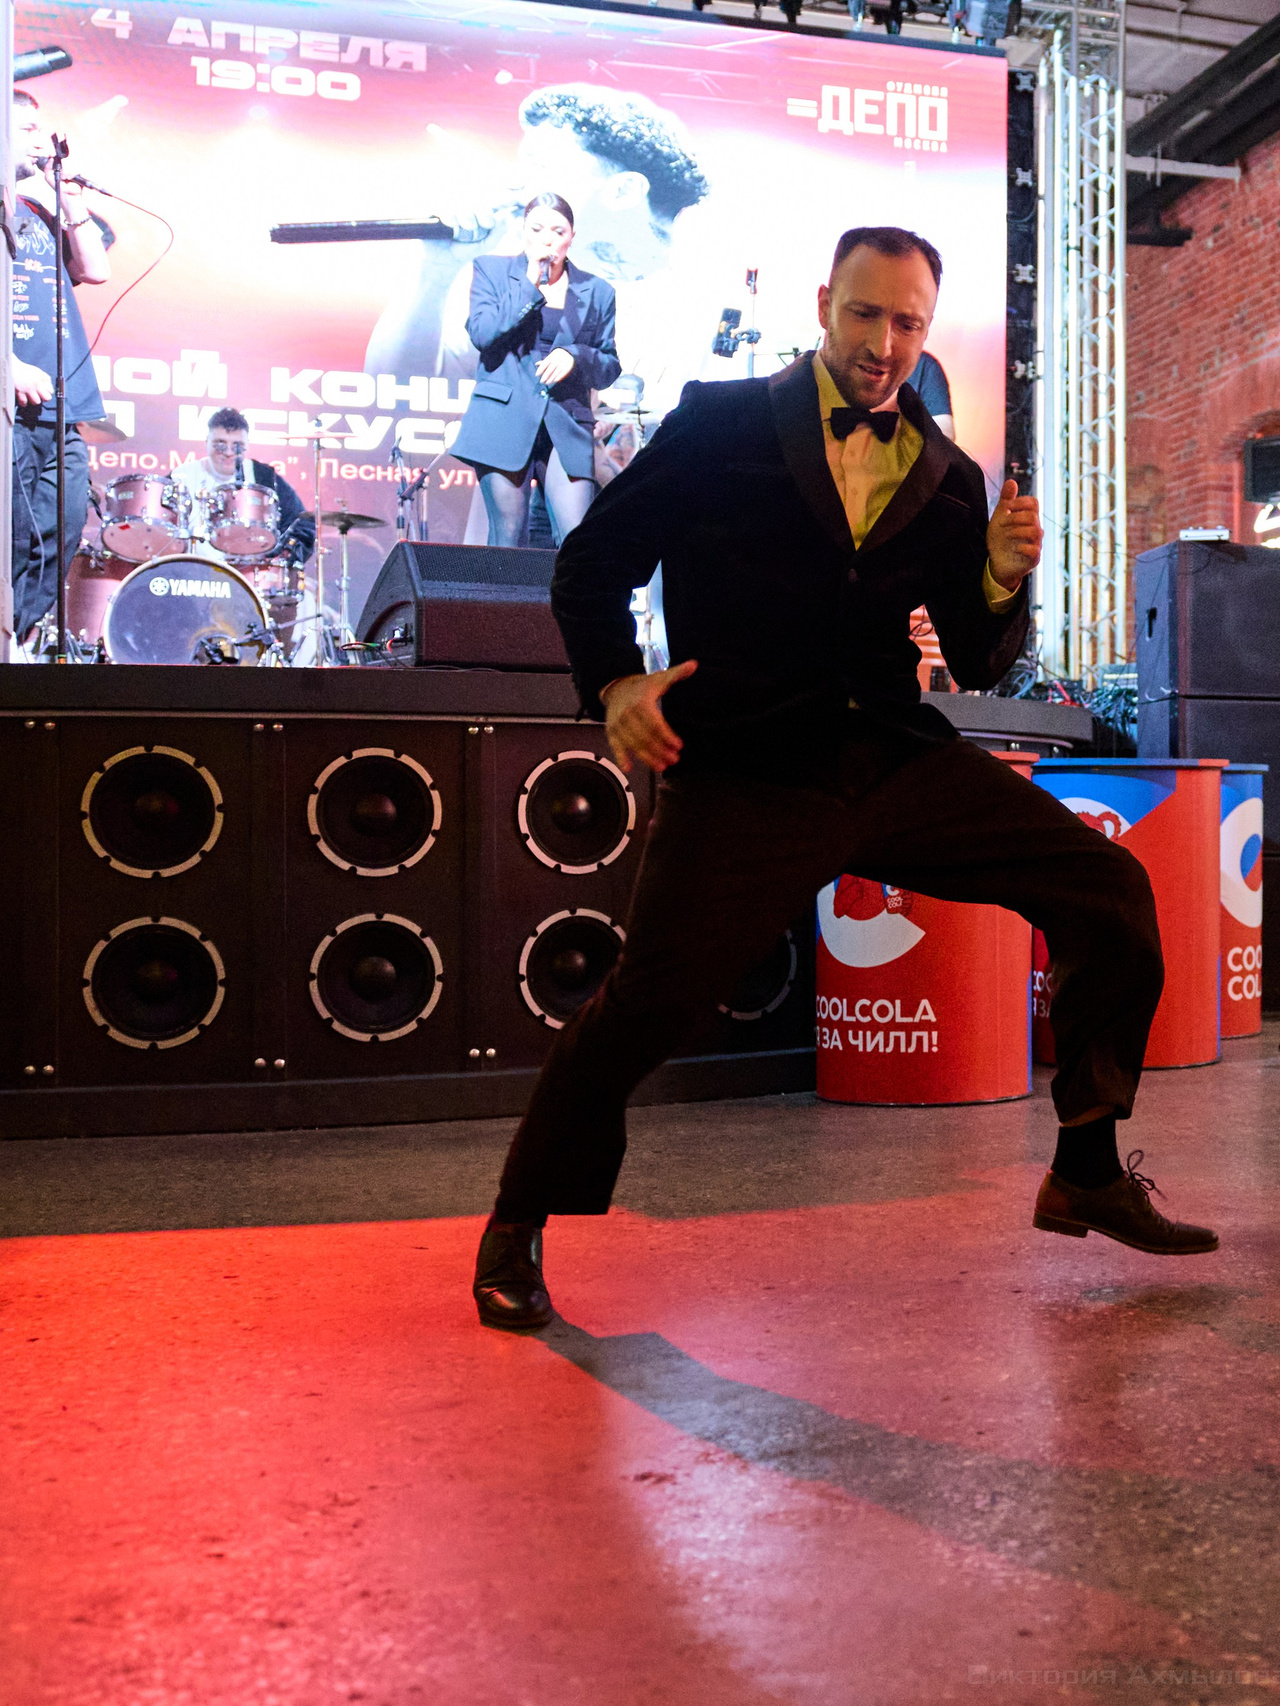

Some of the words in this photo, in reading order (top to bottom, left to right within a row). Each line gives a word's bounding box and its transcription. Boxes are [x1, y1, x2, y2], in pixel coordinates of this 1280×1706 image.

[90, 8, 133, 40] 4
[167, 16, 427, 73] АПРЕЛЯ
[190, 55, 361, 102] 19:00
[169, 578, 232, 599] YAMAHA
[821, 1026, 843, 1051] ЗА
[848, 1029, 938, 1053] ЧИЛЛ!
